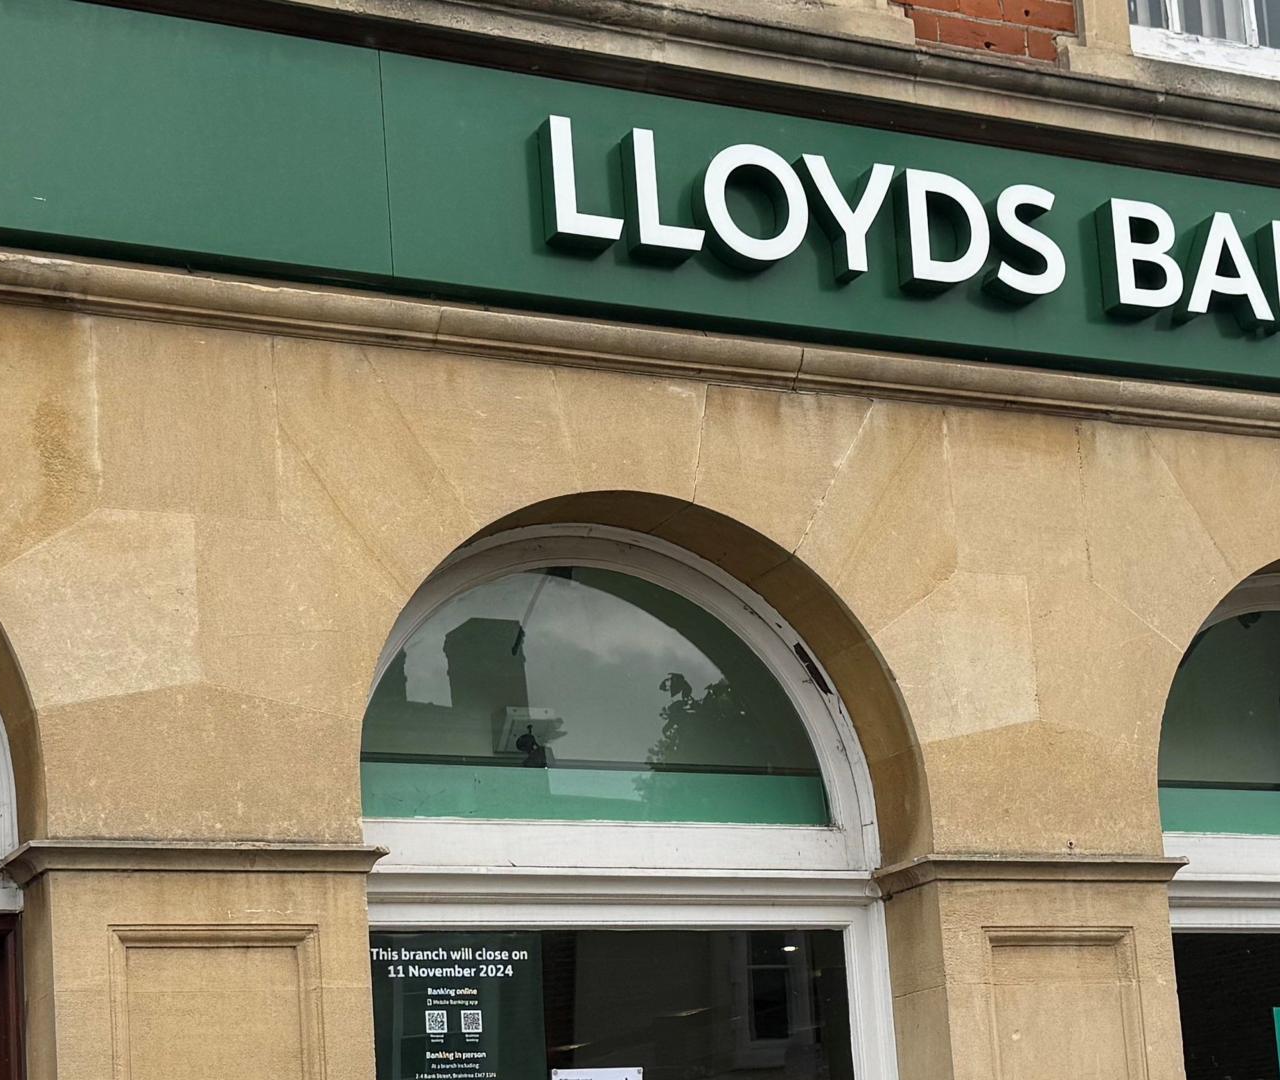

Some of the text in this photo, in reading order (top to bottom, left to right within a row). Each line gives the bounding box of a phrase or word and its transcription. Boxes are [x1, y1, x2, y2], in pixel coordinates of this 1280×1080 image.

[544, 113, 1066, 300] LLOYDS
[370, 947, 528, 960] This branch will close on
[387, 964, 514, 978] 11 November 2024
[427, 987, 478, 996] Banking online
[426, 1051, 454, 1060] Banking
[462, 1052, 487, 1060] person
